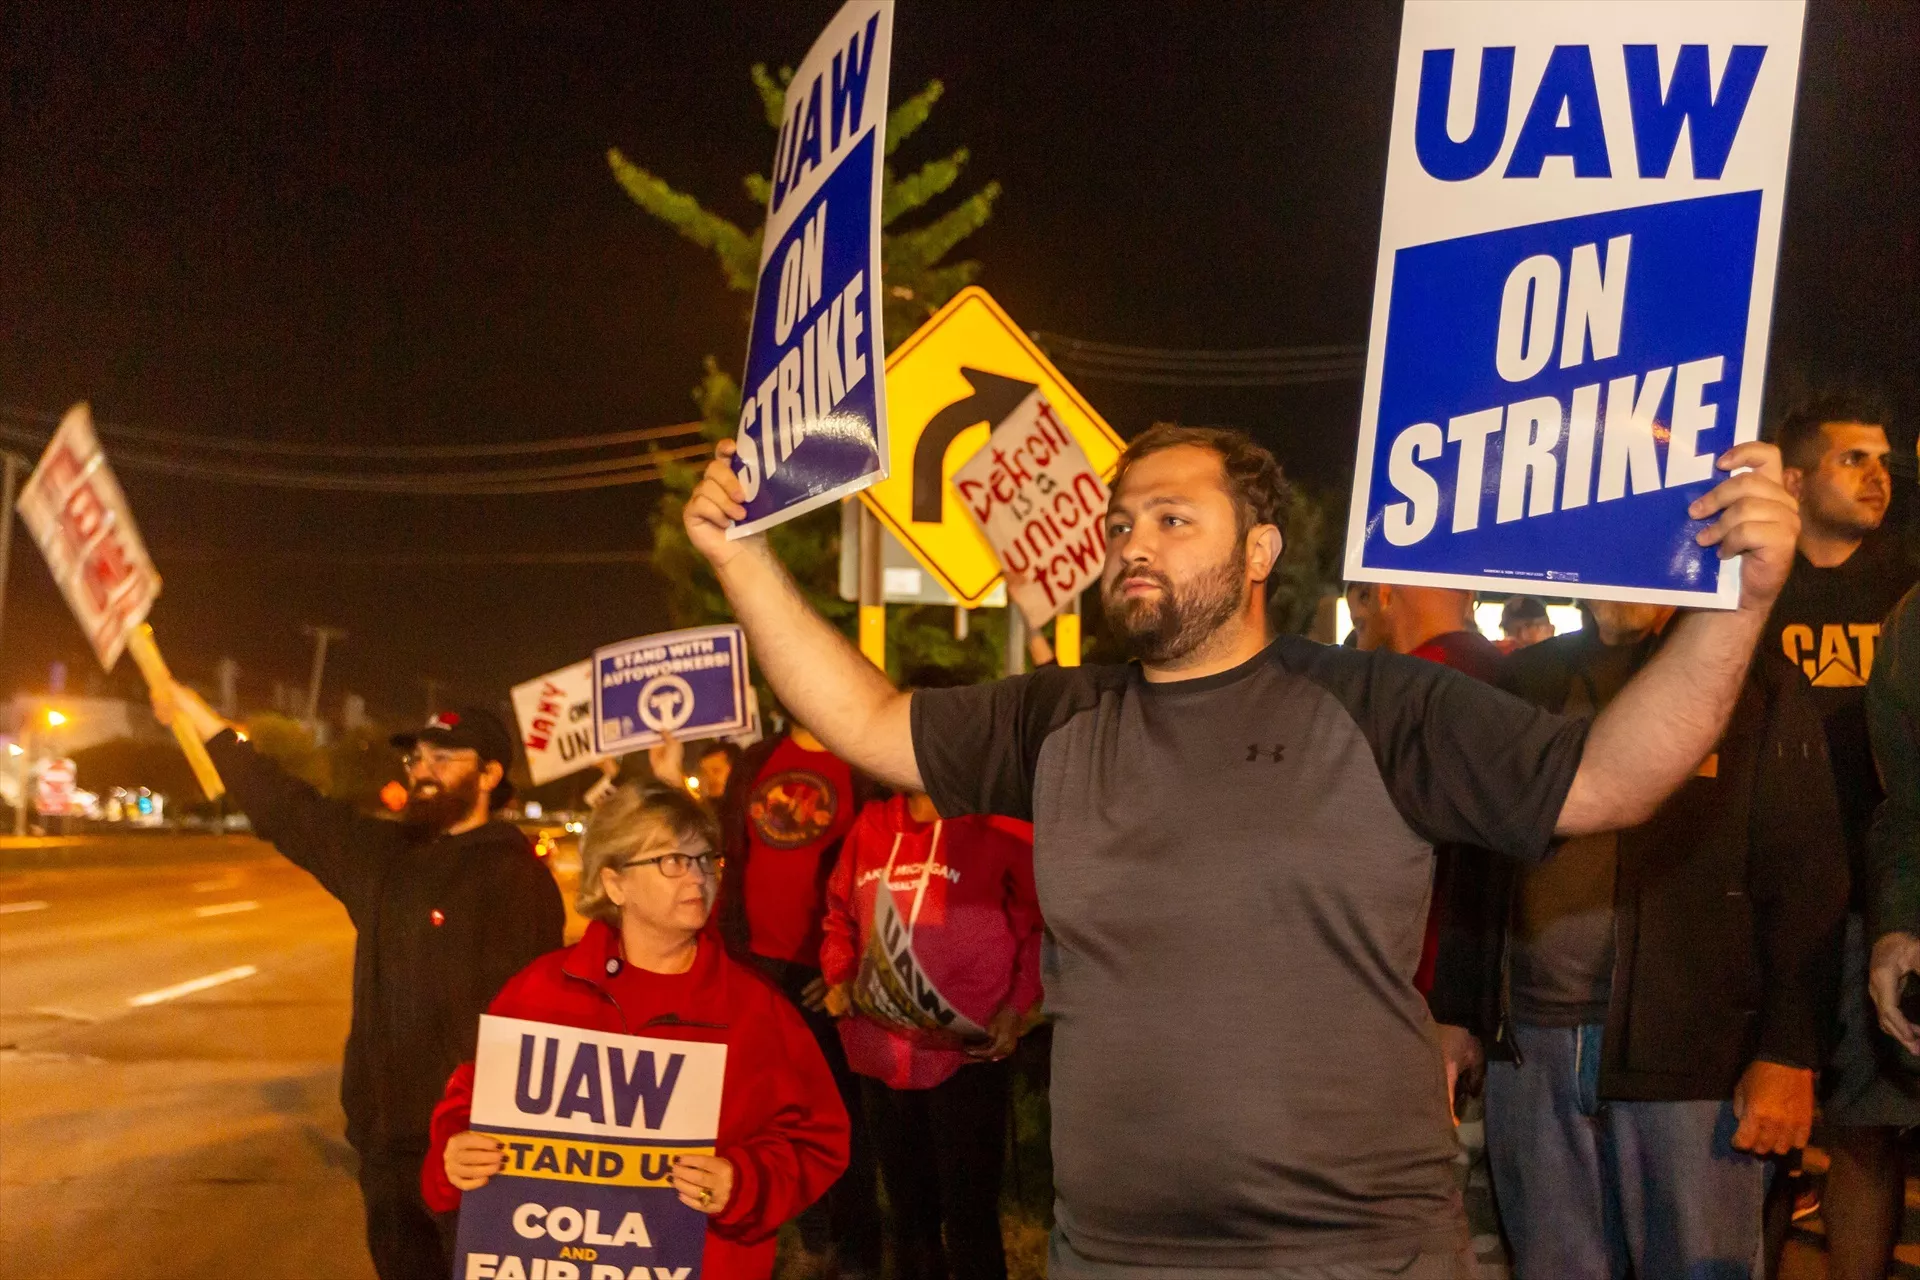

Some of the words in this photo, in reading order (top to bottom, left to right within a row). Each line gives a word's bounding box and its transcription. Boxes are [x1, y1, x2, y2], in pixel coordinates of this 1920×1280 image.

[773, 9, 880, 215] UAW
[1414, 44, 1768, 182] UAW
[775, 199, 828, 346] ON
[1496, 233, 1632, 383] ON
[736, 269, 867, 503] STRIKE
[1383, 355, 1725, 547] STRIKE
[602, 651, 730, 689] AUTOWORKERS!
[613, 646, 667, 671] STAND
[667, 639, 715, 661] WITH
[1781, 623, 1881, 687] CAT
[514, 1033, 686, 1131] UAW
[501, 1141, 625, 1179] TAND
[640, 1153, 676, 1181] U
[512, 1202, 653, 1248] COLA
[559, 1246, 598, 1262] AND
